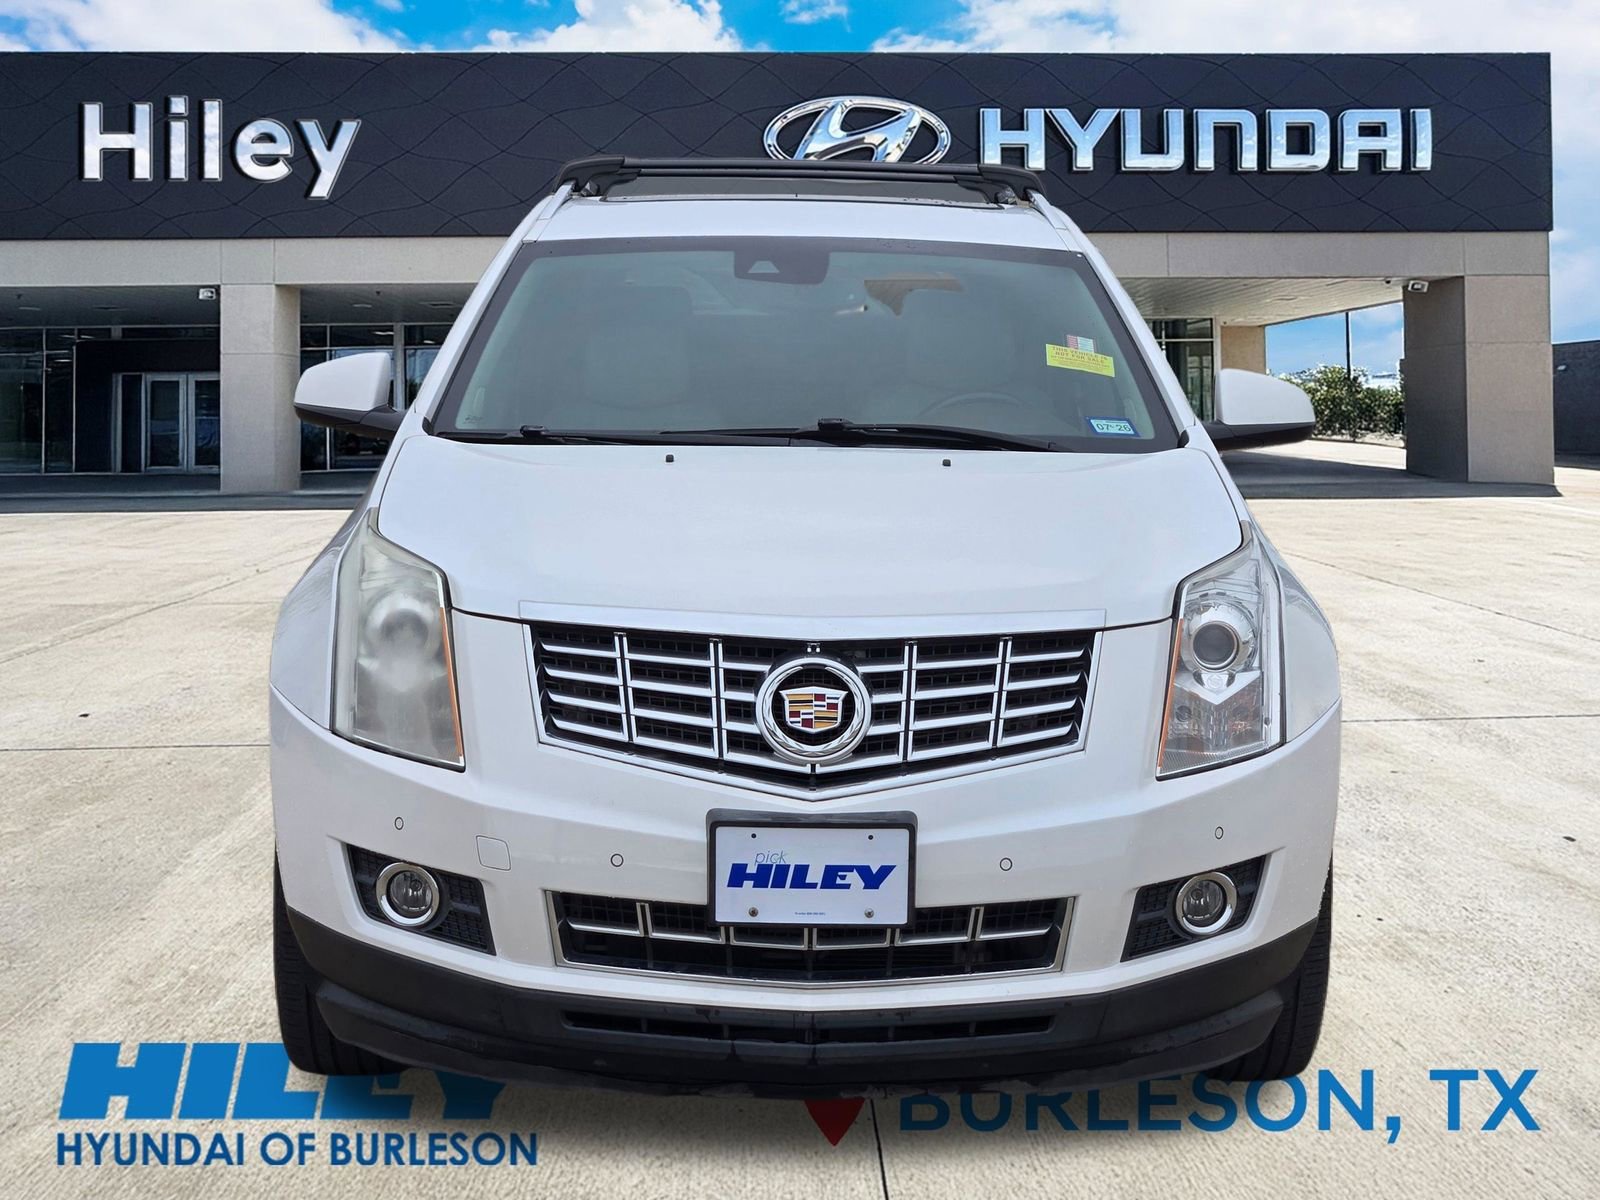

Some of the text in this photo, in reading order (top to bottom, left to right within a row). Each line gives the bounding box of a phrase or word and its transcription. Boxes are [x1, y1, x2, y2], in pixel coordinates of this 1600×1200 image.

[80, 95, 361, 199] Hiley
[979, 107, 1432, 172] HYUNDAI
[727, 863, 897, 890] HILEY
[754, 850, 788, 865] pick
